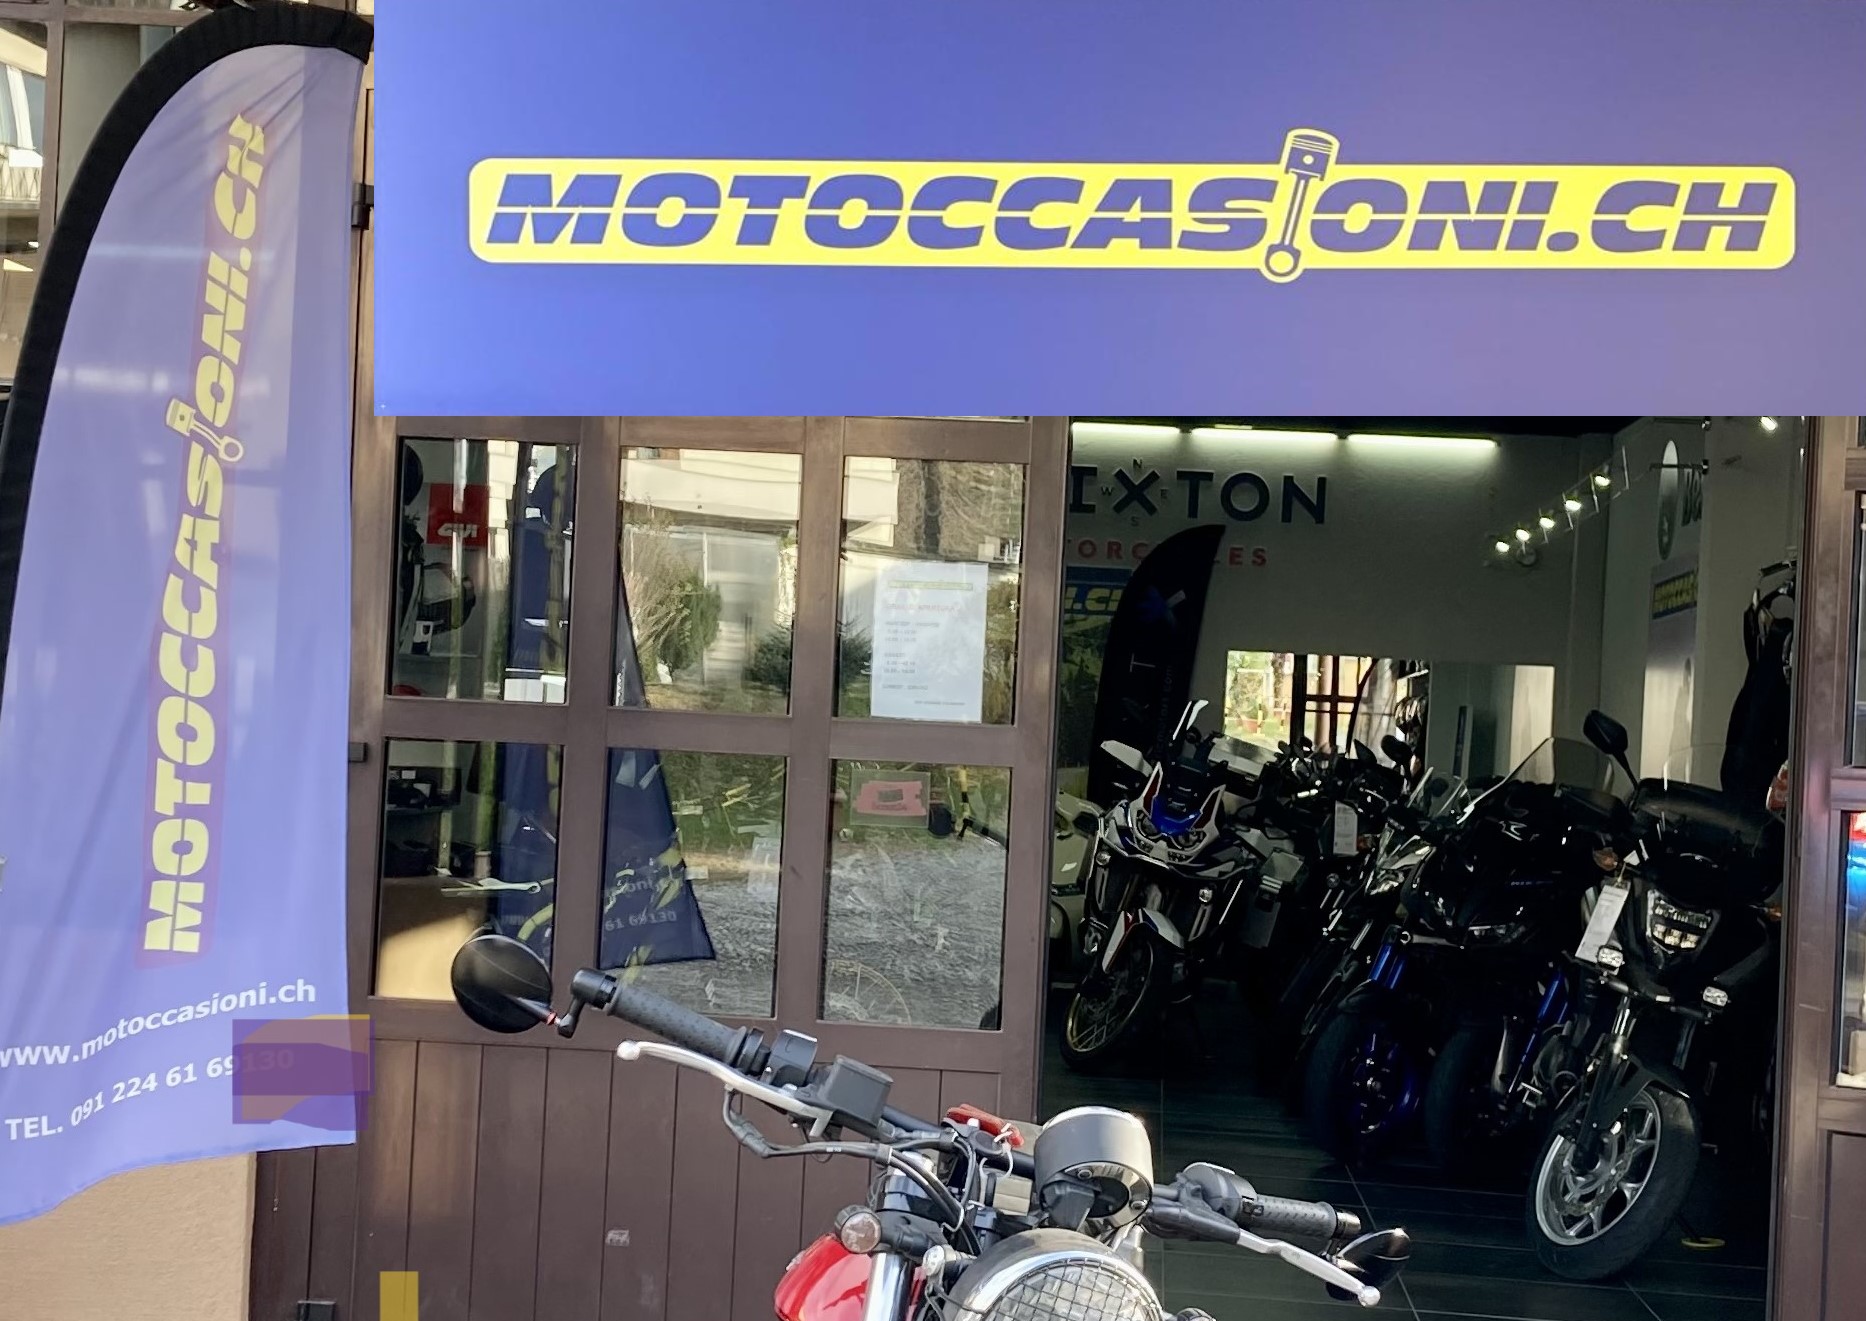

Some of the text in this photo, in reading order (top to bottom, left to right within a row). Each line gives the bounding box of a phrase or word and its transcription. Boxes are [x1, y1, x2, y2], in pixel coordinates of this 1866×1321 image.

[486, 134, 1778, 276] MOTOCCASIONI.CH
[143, 113, 266, 953] MOTOCCASIONI.CH
[4, 1115, 63, 1141] TEL.
[71, 1091, 105, 1126] 091
[111, 1073, 159, 1103] 224
[165, 1053, 198, 1087] 61
